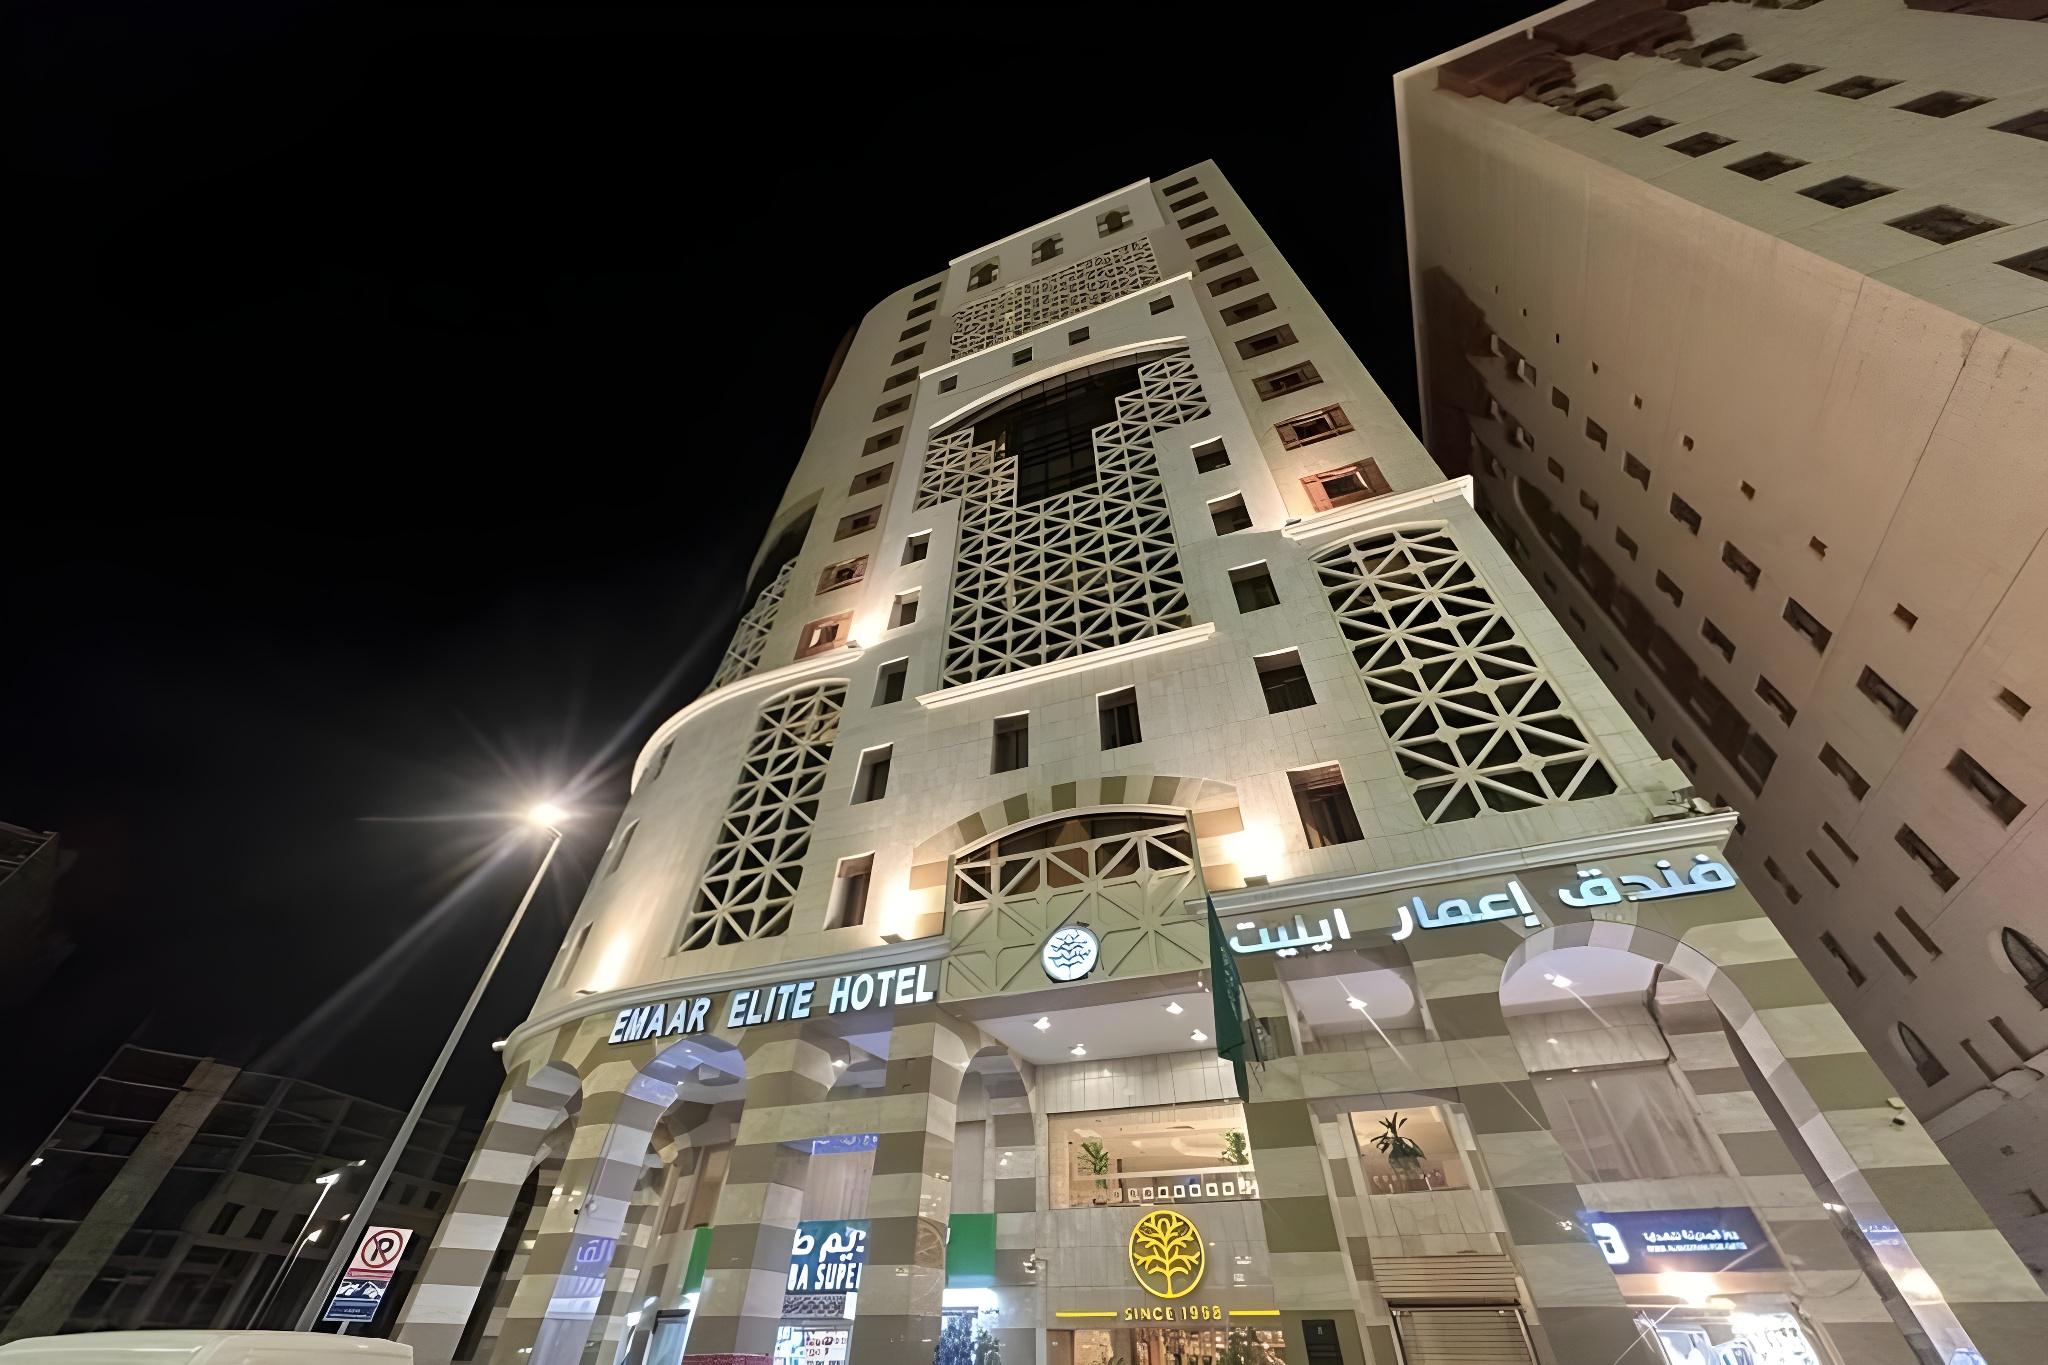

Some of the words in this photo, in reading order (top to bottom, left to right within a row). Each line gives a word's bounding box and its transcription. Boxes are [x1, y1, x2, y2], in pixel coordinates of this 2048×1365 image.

[1559, 854, 1736, 908] فندق
[1229, 908, 1351, 957] ايليت
[1392, 880, 1542, 941] إعمار
[608, 996, 711, 1044] EMAAR
[727, 981, 815, 1028] ELITE
[828, 964, 935, 1014] HOTEL
[1124, 1306, 1176, 1321] SINCE
